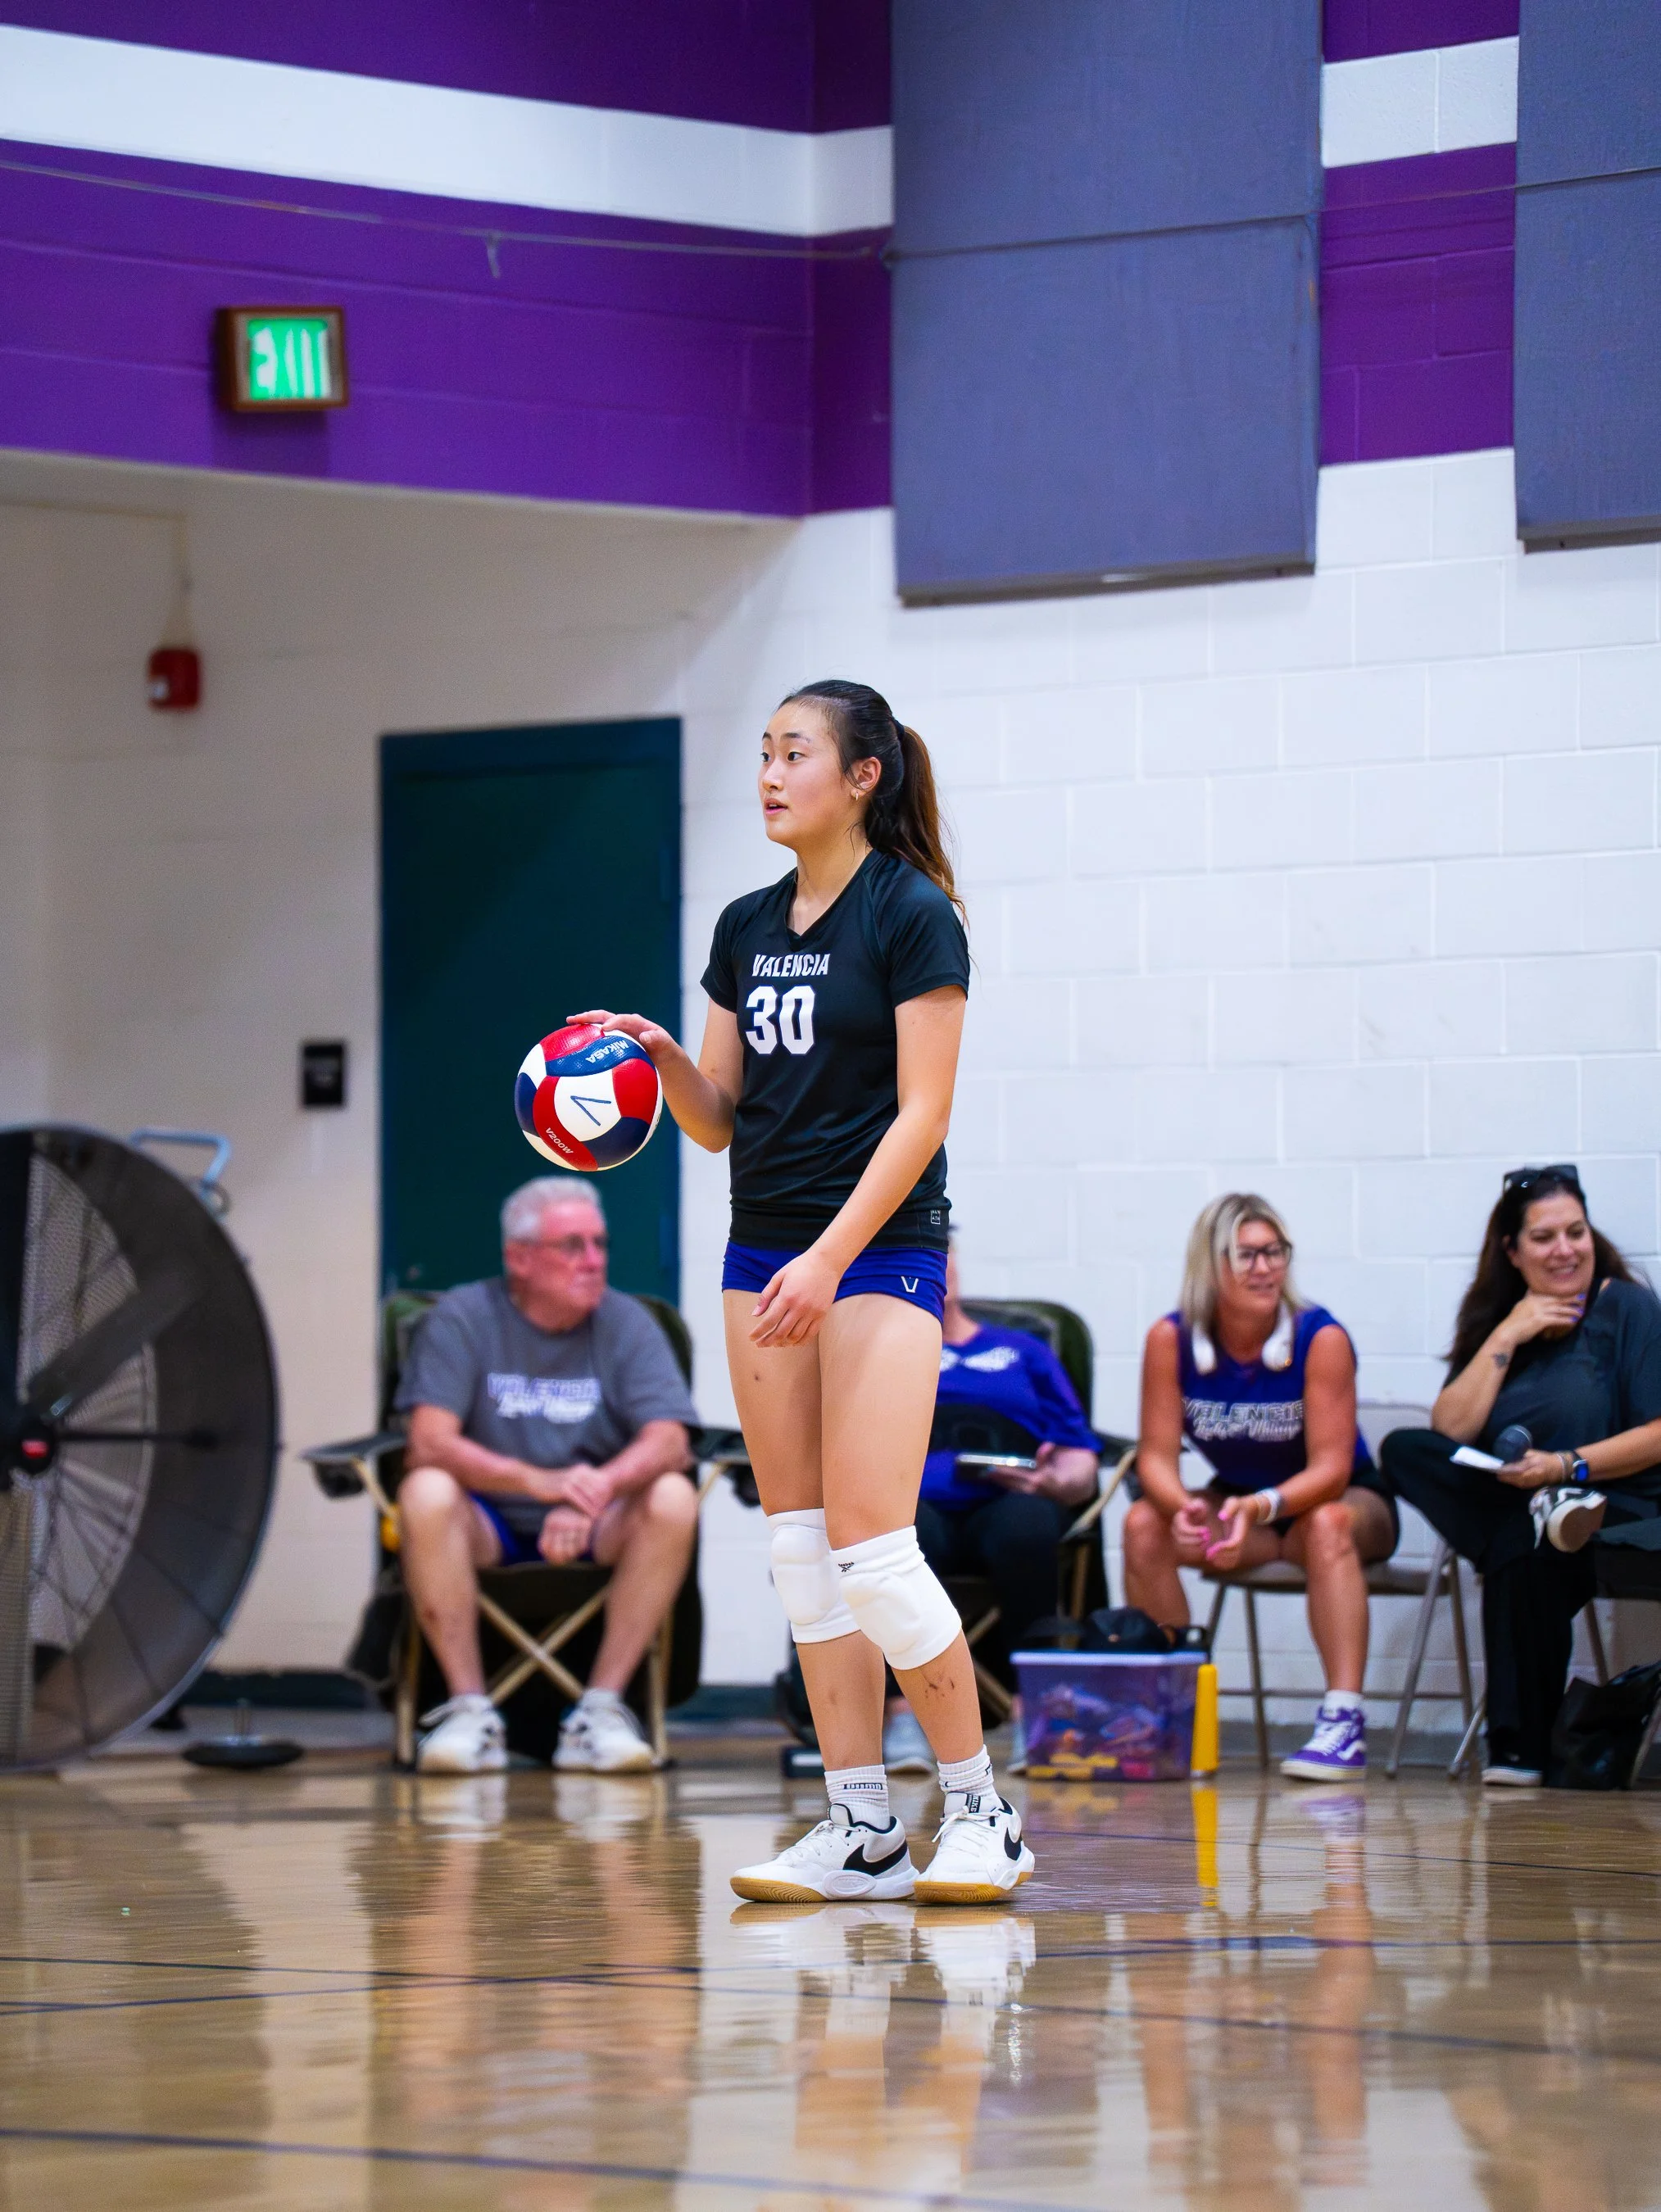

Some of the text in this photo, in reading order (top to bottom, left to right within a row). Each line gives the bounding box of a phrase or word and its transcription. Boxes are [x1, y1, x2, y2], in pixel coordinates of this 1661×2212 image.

[751, 953, 831, 977] VALENCIA
[745, 985, 815, 1054] 30
[584, 1040, 629, 1064] MIKASA
[545, 1127, 574, 1154] V200W
